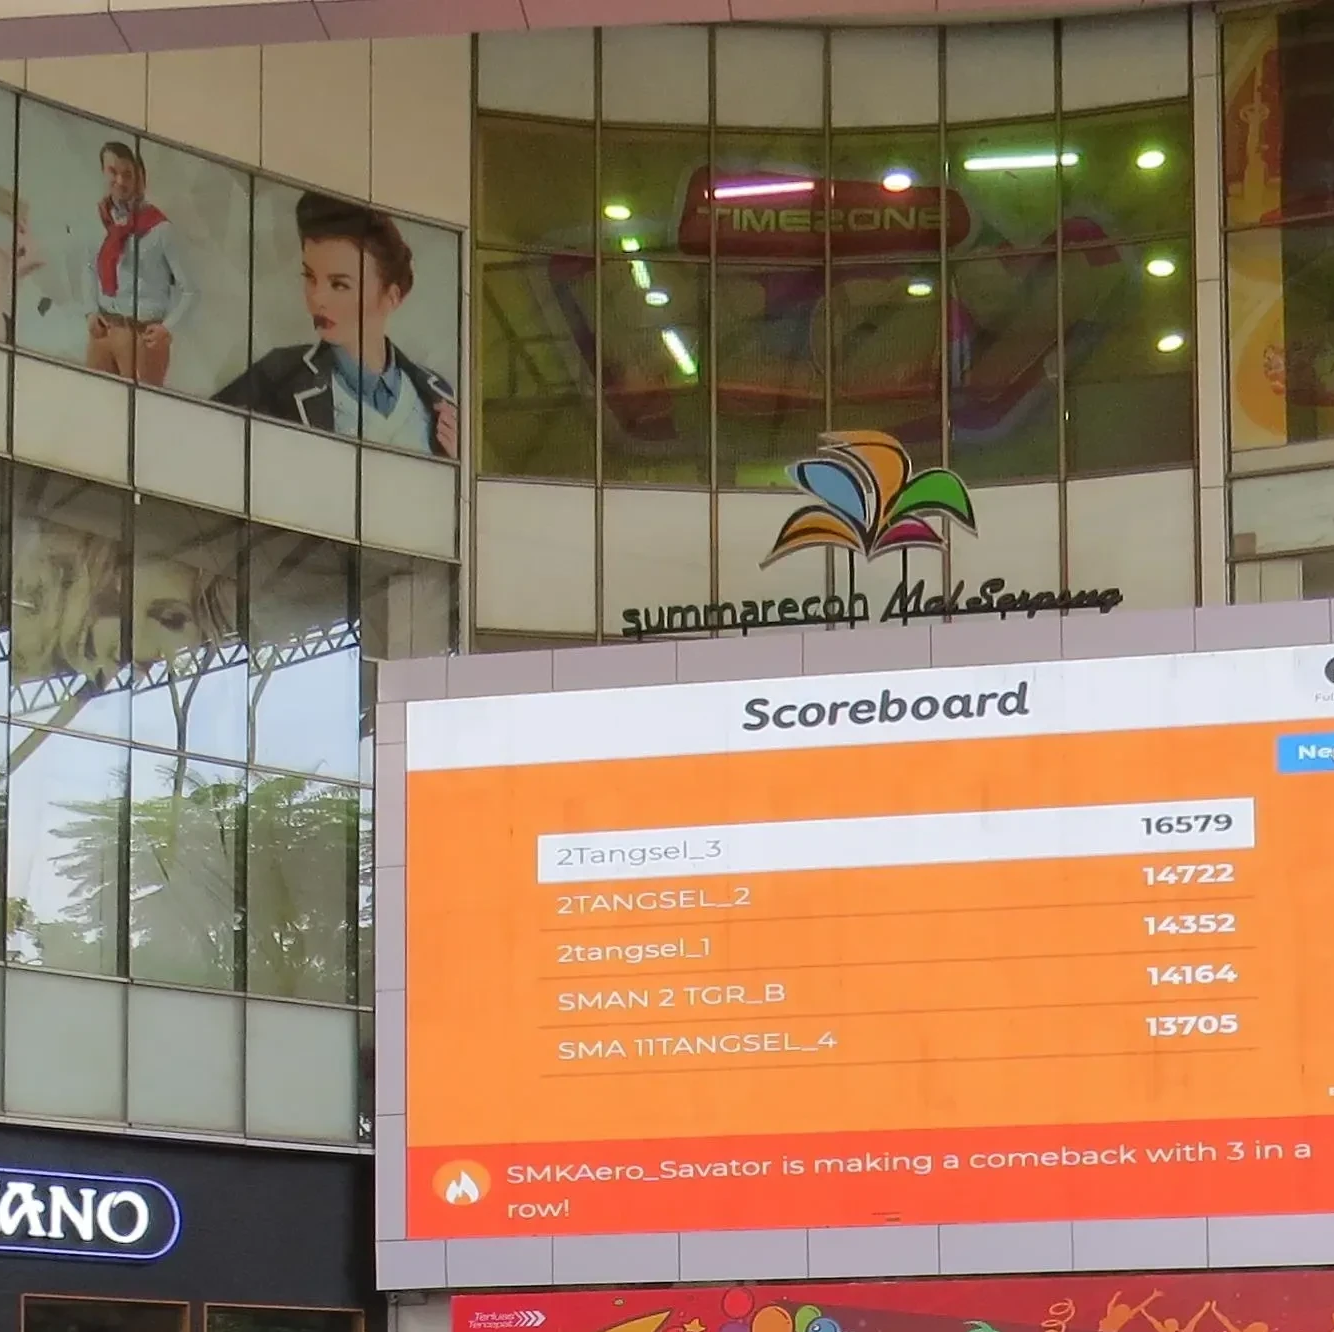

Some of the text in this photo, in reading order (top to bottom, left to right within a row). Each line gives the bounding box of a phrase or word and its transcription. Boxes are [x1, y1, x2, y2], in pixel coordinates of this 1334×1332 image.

[697, 206, 950, 233] TIMEZONE
[622, 592, 870, 635] summarecon
[742, 681, 1030, 731] Scoreboard
[1141, 813, 1233, 835] 16579
[556, 840, 723, 866] 2Tangsel_3
[1142, 863, 1235, 885] 14722
[557, 887, 752, 914] 2TANGSEL_2
[1144, 913, 1236, 935] 14352
[557, 938, 711, 964] 2tangsel_1
[1147, 963, 1238, 985] 14164
[558, 983, 786, 1011] SMAN 2 TGR_B
[1145, 1013, 1239, 1036] 13705
[558, 1031, 838, 1060] SMA 11TANGSEL_4
[506, 1139, 1312, 1184] SMKAero_Savator is making a comeback with 3 in a
[507, 1199, 570, 1219] row!
